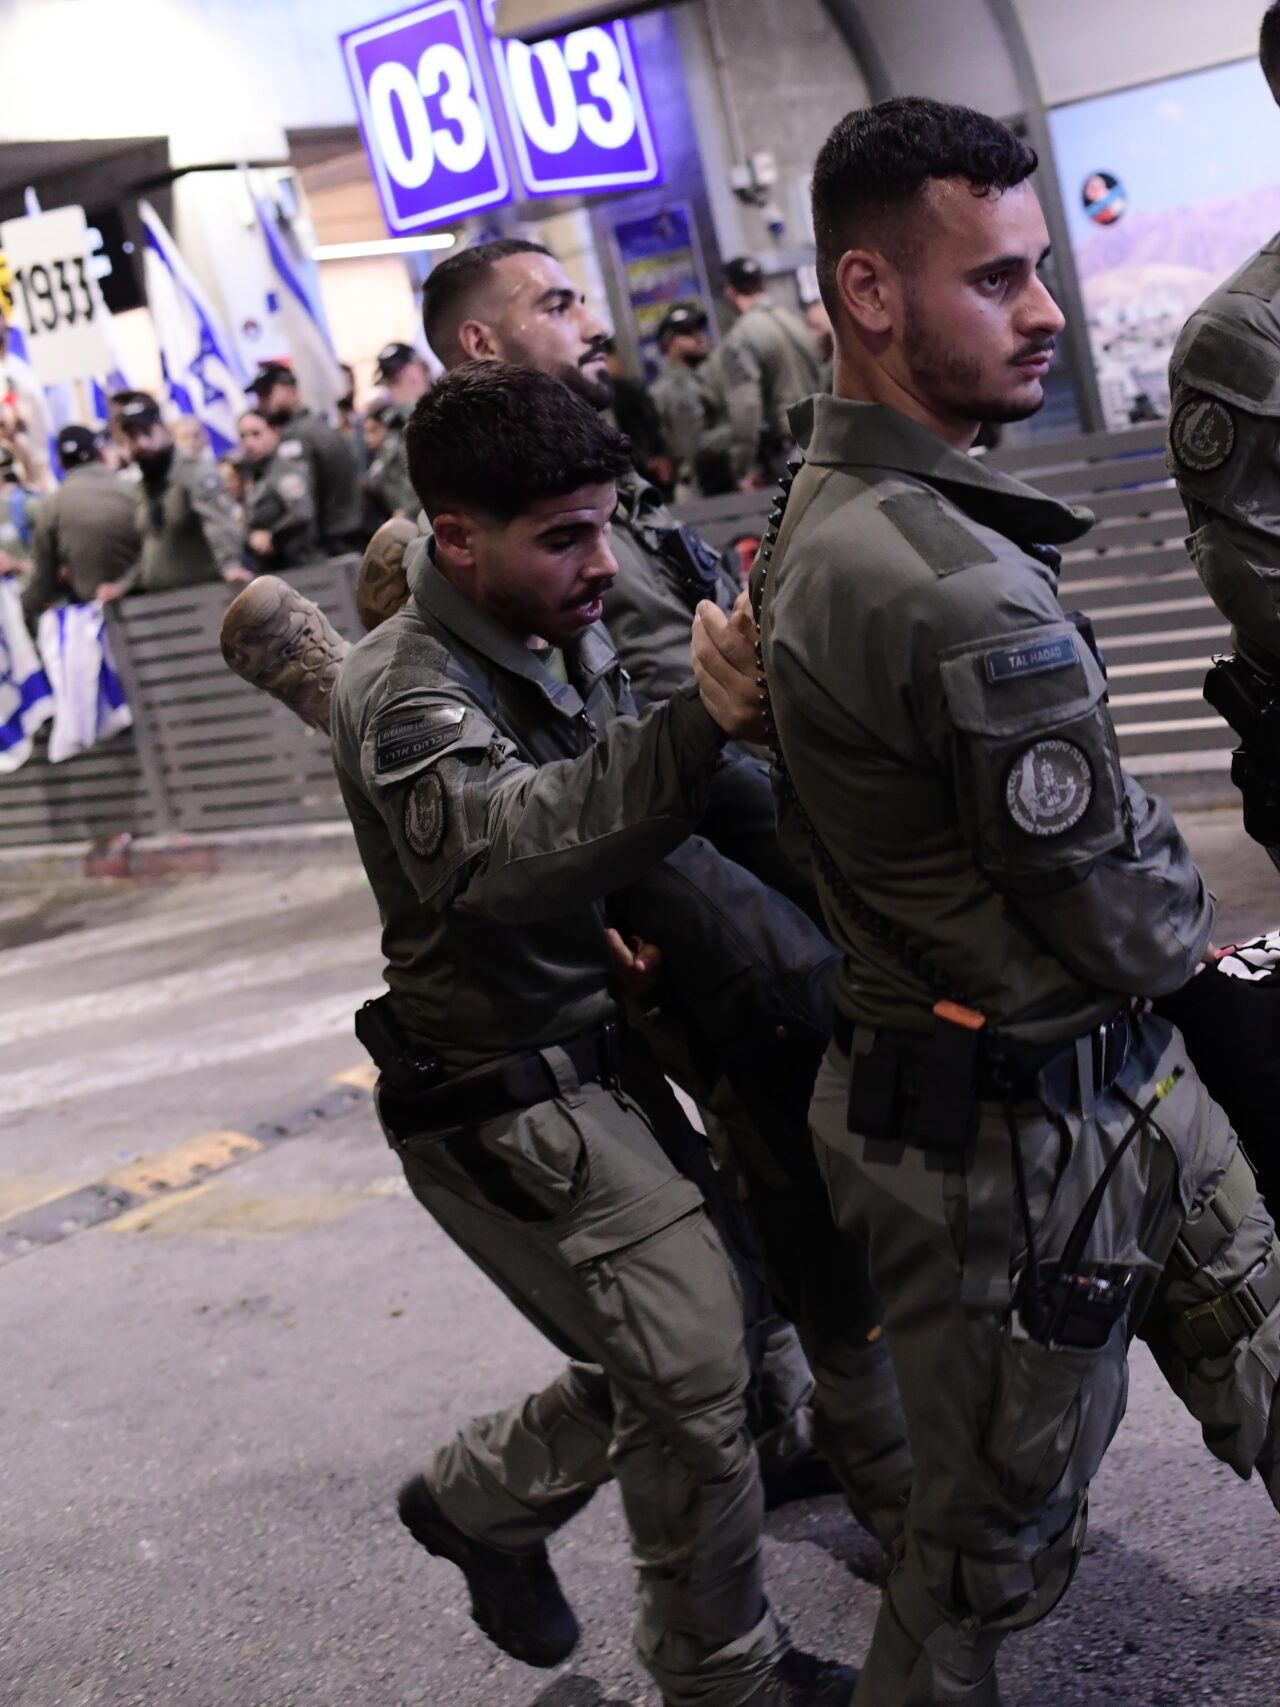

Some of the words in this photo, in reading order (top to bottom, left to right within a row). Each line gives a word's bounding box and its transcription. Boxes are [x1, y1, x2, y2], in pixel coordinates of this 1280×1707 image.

[506, 26, 636, 154] 03
[369, 43, 486, 189] 03
[15, 257, 94, 335] 1933
[1008, 655, 1029, 669] TAL
[1030, 646, 1062, 664] HADAD
[385, 746, 410, 760] אדרי
[413, 732, 453, 752] אברהם
